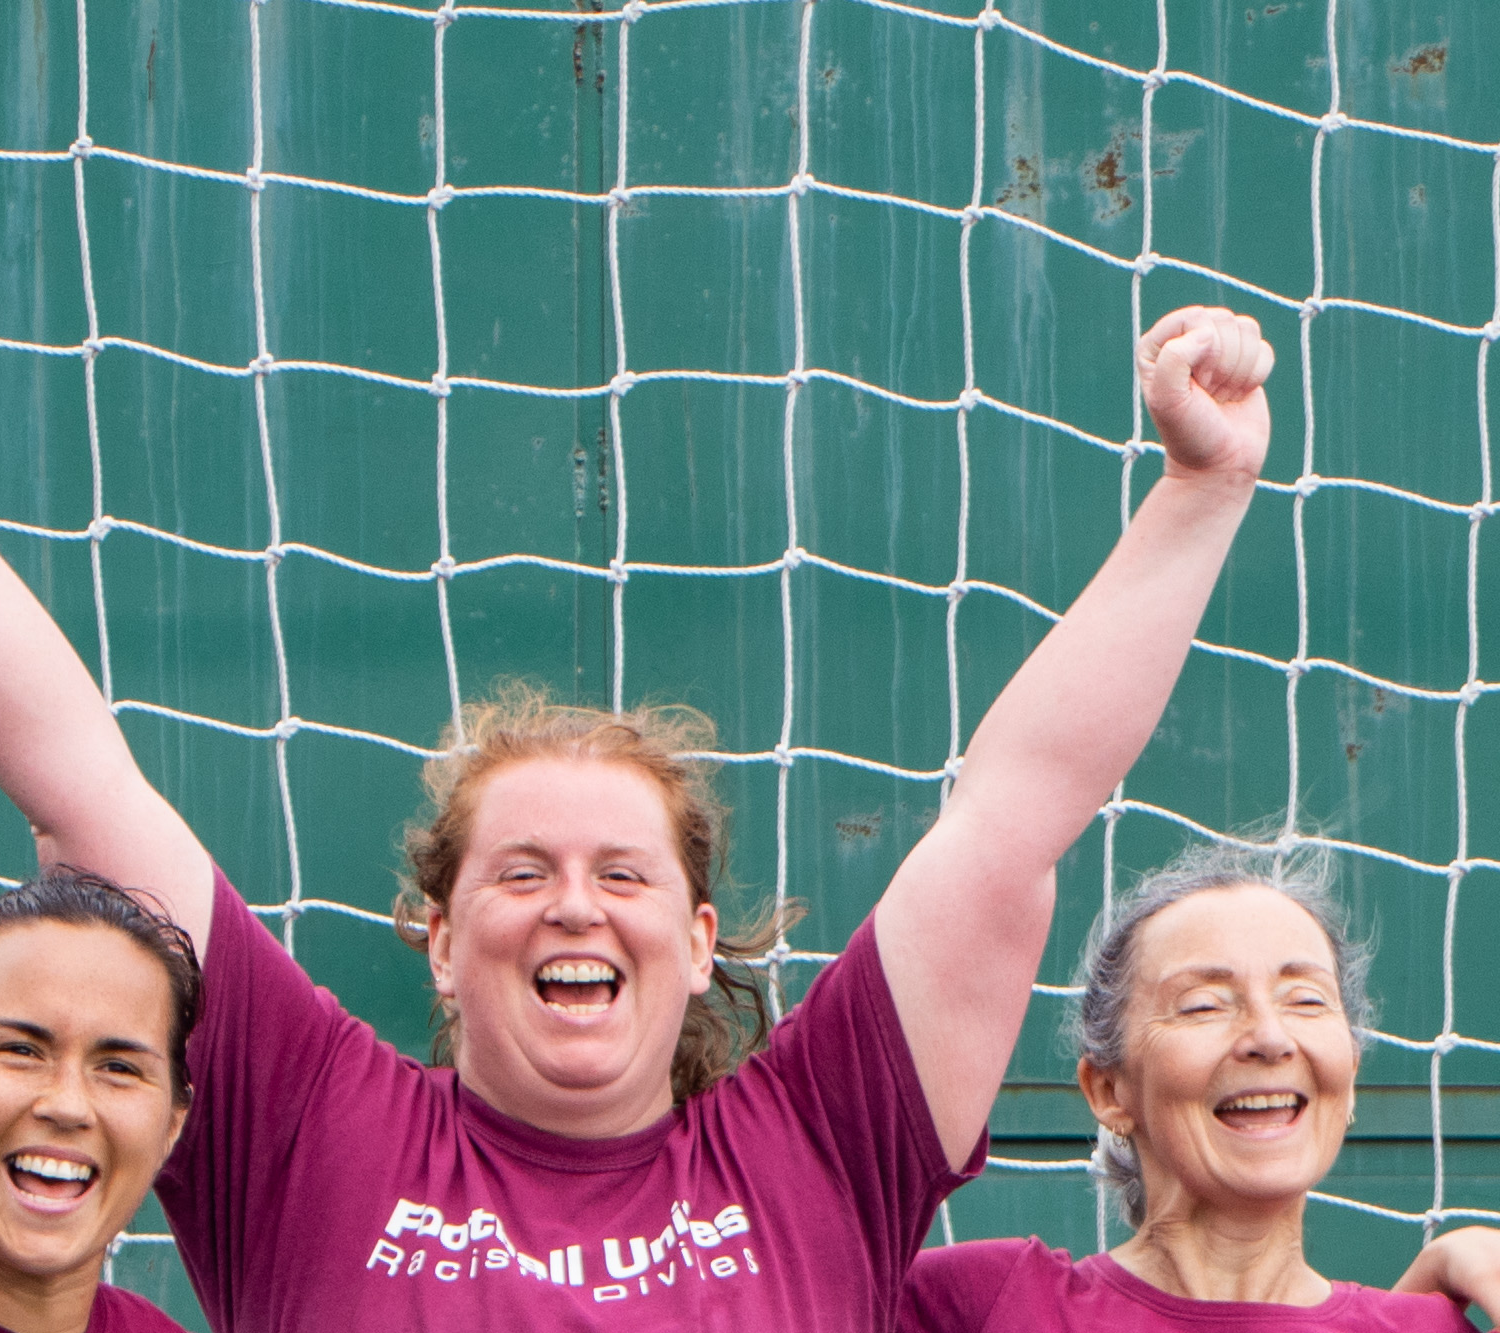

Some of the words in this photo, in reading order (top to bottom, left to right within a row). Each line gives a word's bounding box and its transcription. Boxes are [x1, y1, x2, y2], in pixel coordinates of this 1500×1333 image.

[366, 1239, 510, 1281] Racis
[593, 1241, 759, 1303] Divies
[385, 1198, 583, 1286] Footall
